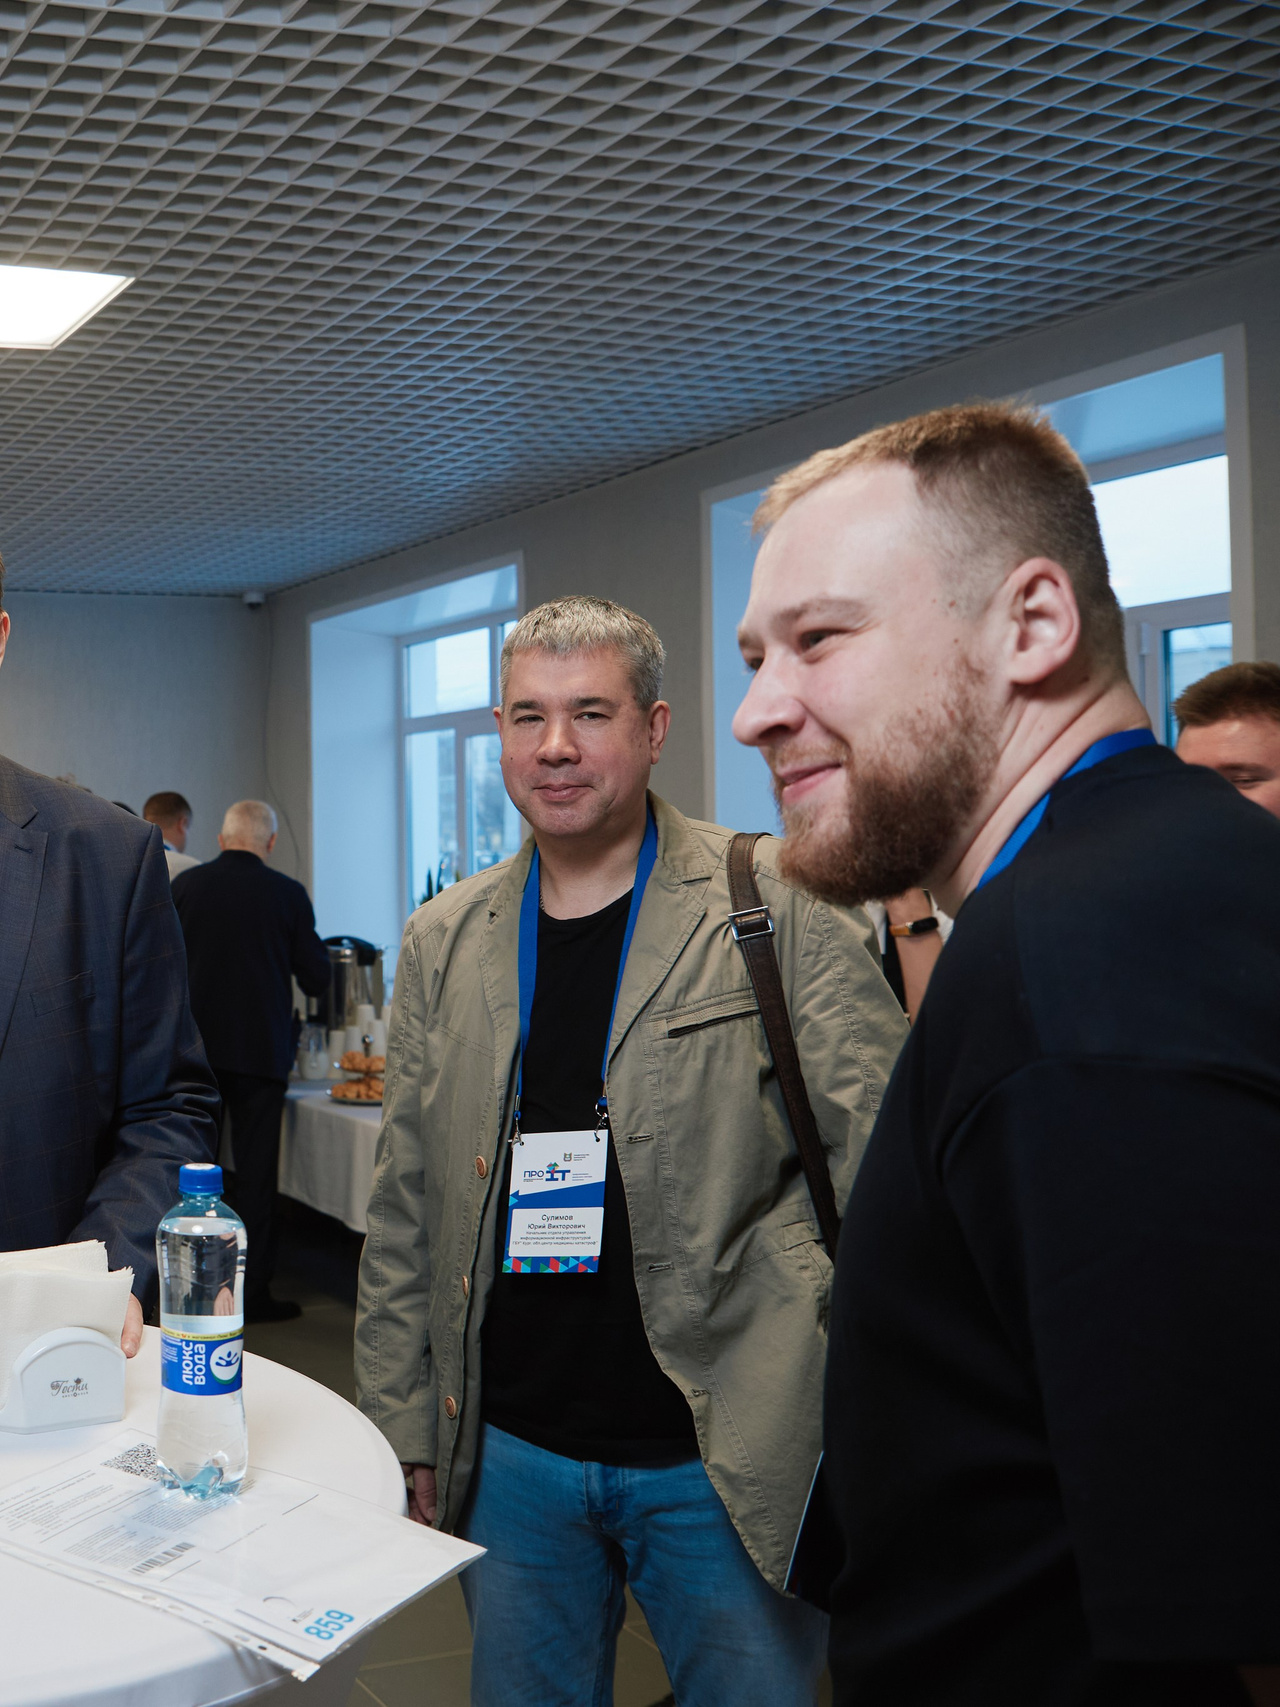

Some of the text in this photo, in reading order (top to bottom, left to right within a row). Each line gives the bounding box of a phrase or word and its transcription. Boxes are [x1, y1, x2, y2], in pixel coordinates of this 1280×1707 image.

[523, 1170, 545, 1178] ПРО
[541, 1214, 574, 1222] Сулимов
[304, 1609, 355, 1641] 859
